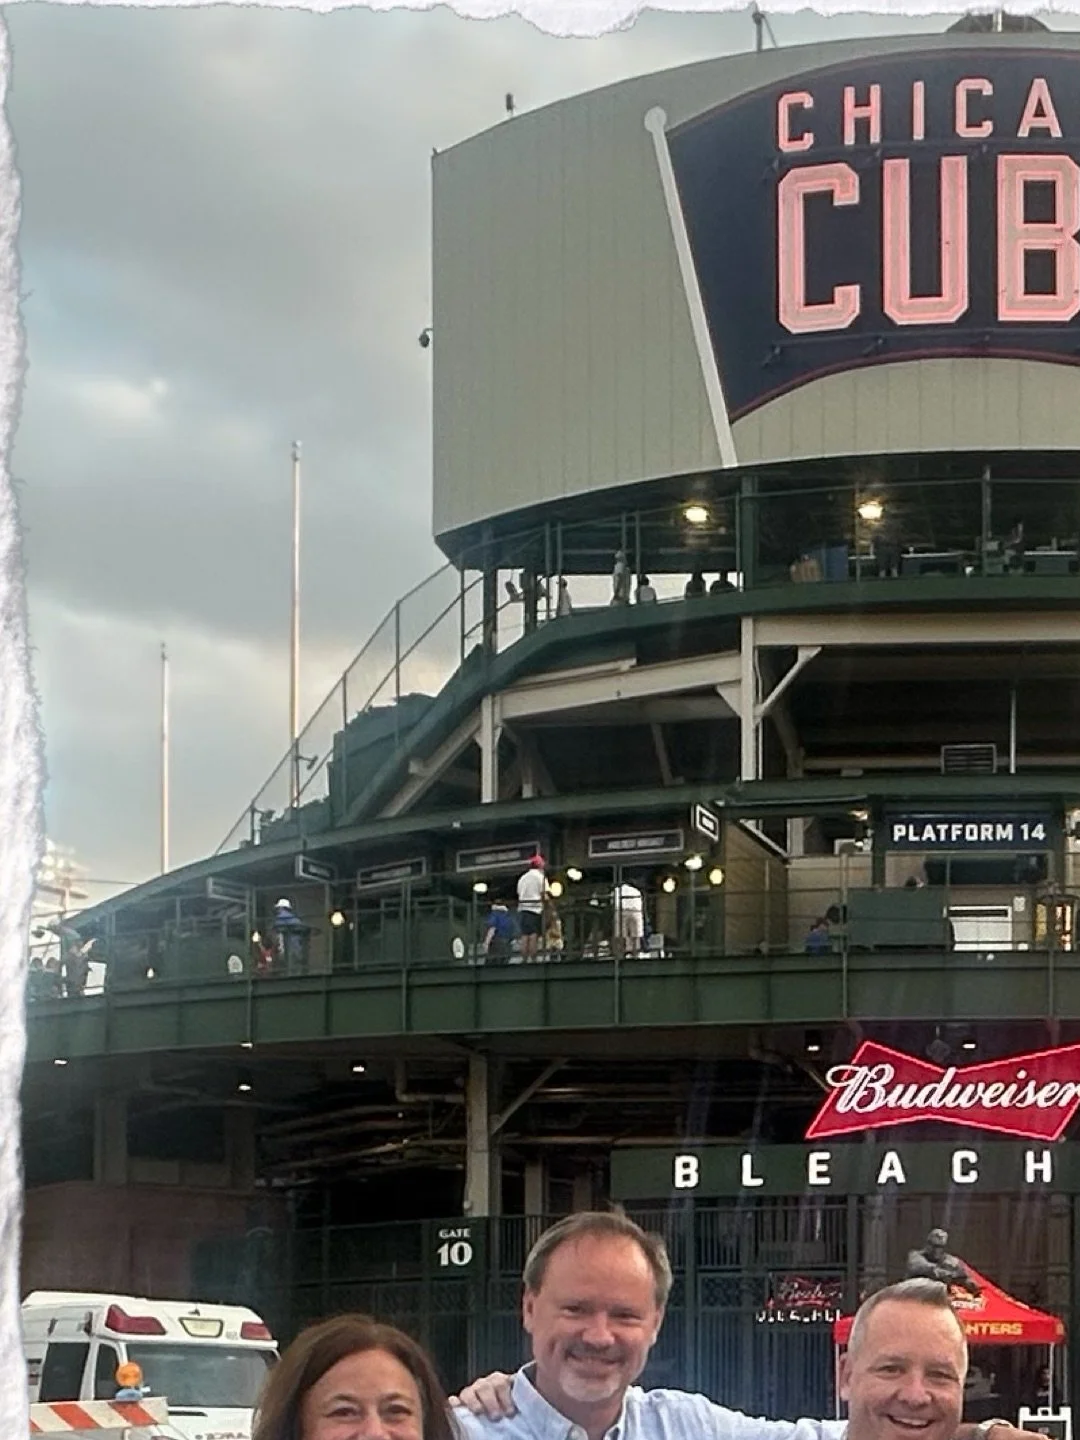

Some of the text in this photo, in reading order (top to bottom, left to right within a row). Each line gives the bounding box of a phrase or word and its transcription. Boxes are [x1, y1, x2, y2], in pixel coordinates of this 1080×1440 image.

[892, 822, 1047, 842] PLATFORM 14
[438, 1228, 471, 1240] GATE
[436, 1241, 473, 1267] 10
[964, 1322, 1024, 1336] HTERS
